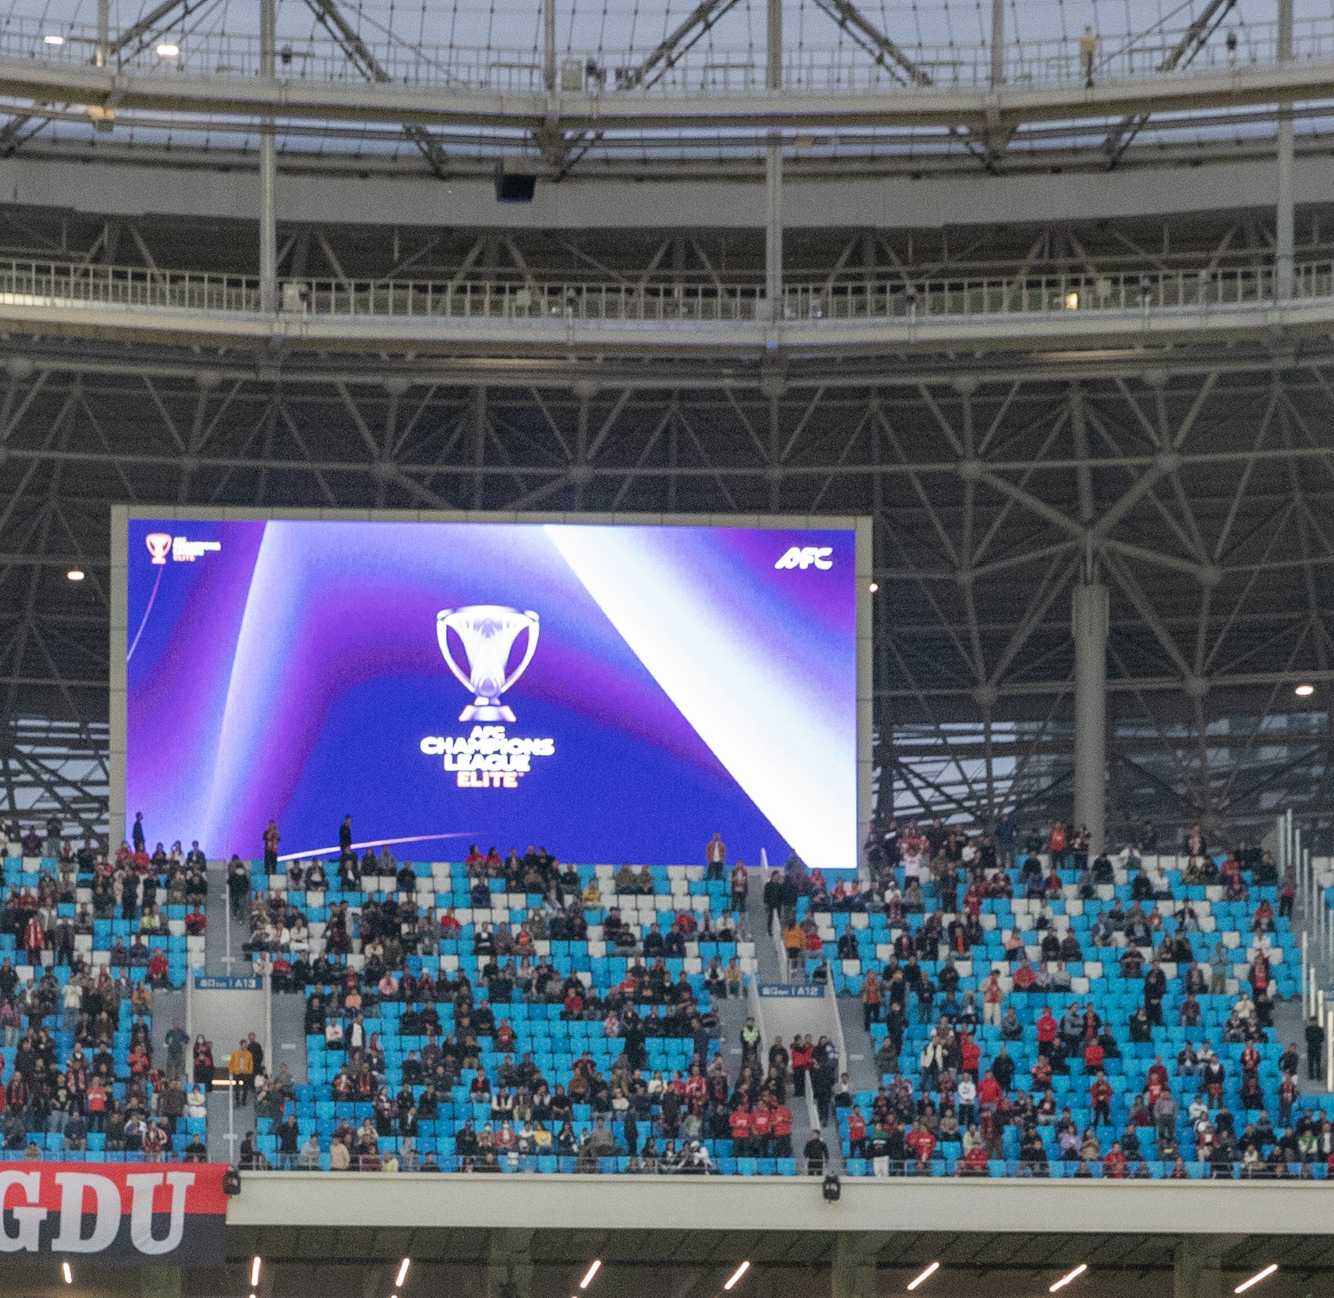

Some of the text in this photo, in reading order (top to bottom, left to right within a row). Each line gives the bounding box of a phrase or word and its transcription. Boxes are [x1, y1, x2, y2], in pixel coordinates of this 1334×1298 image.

[774, 546, 833, 570] AFC
[420, 736, 555, 756] CHAMPIONS
[444, 753, 531, 772] LEAGUE
[456, 770, 518, 788] ELITE
